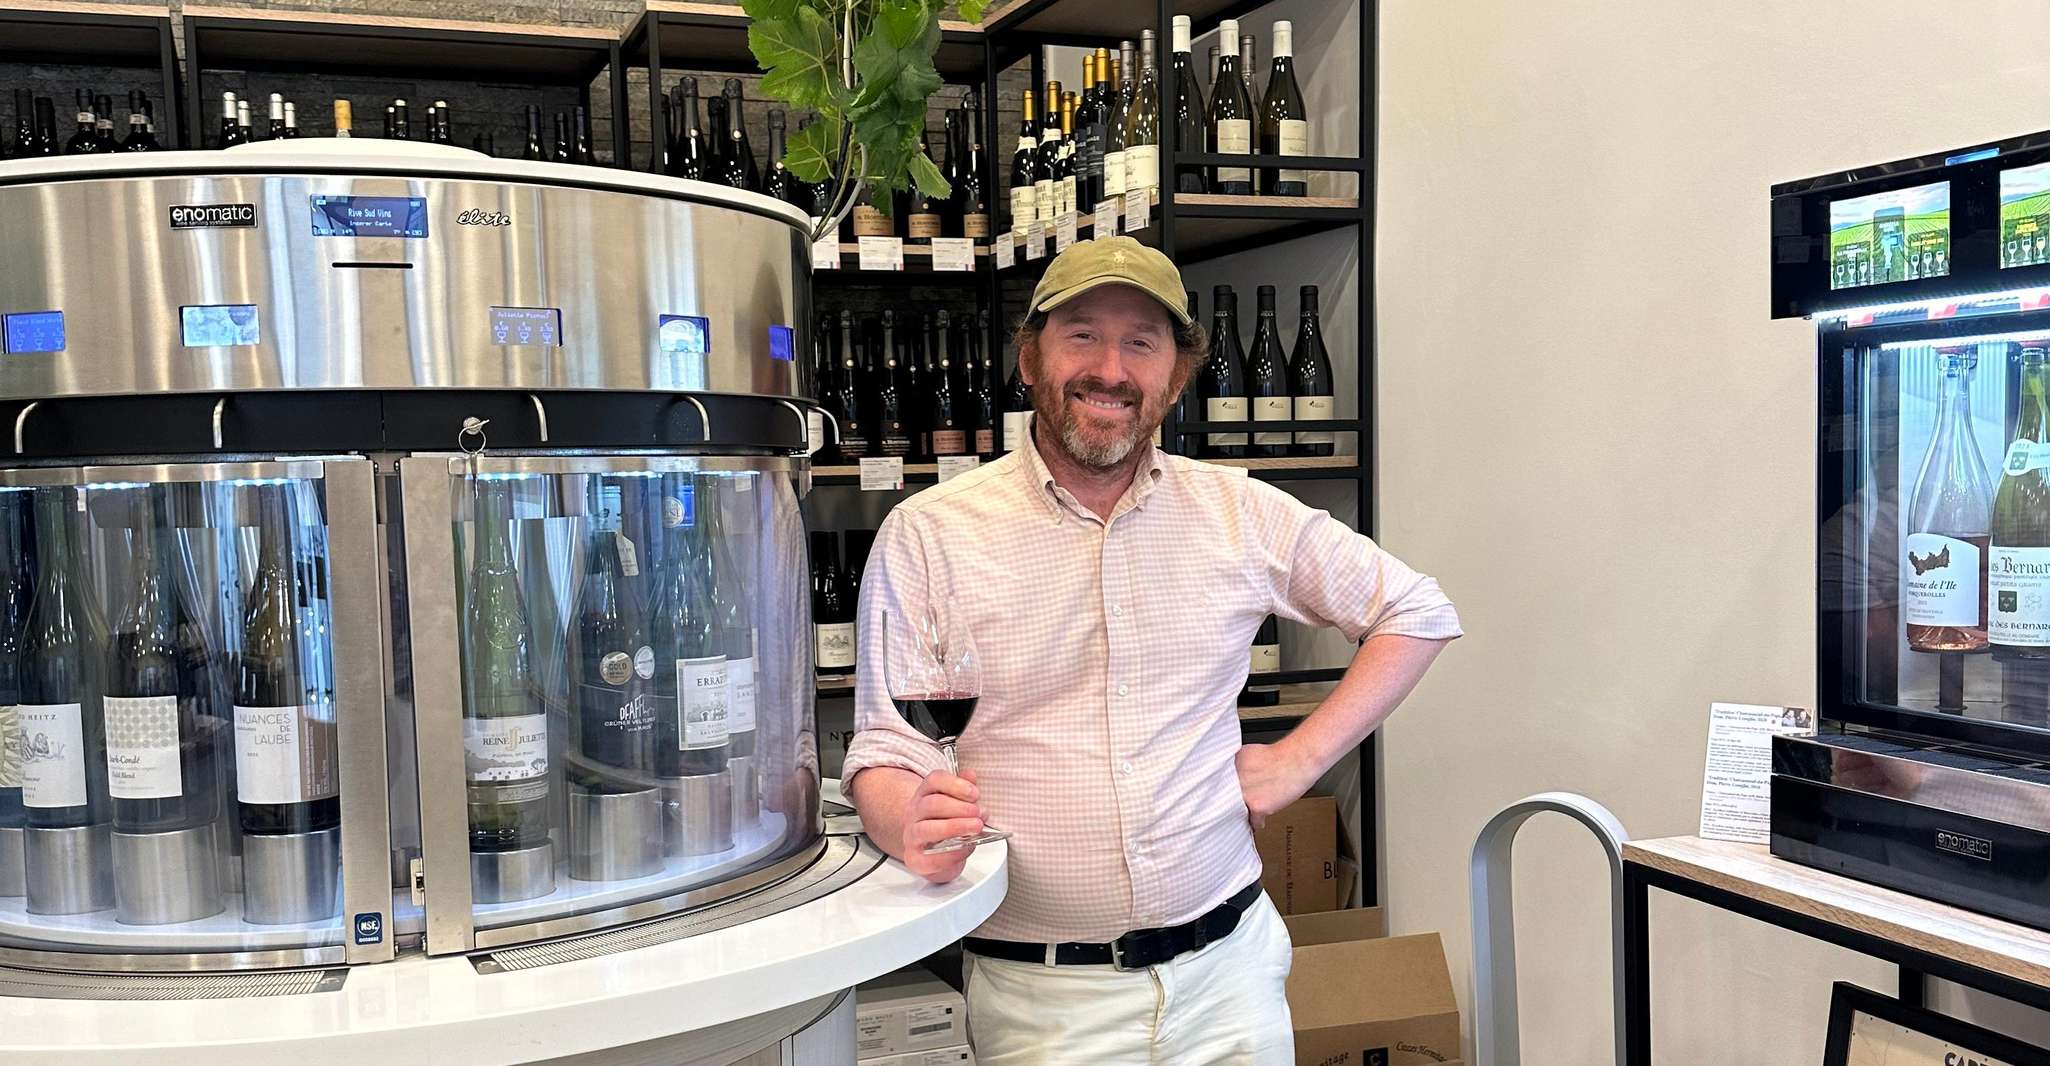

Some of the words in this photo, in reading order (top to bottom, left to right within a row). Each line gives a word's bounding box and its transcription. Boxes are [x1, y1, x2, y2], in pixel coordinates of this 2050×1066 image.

[172, 205, 252, 221] enomatic
[1929, 580, 1938, 589] de
[482, 737, 510, 746] REINE
[1937, 832, 1988, 854] enomatic
